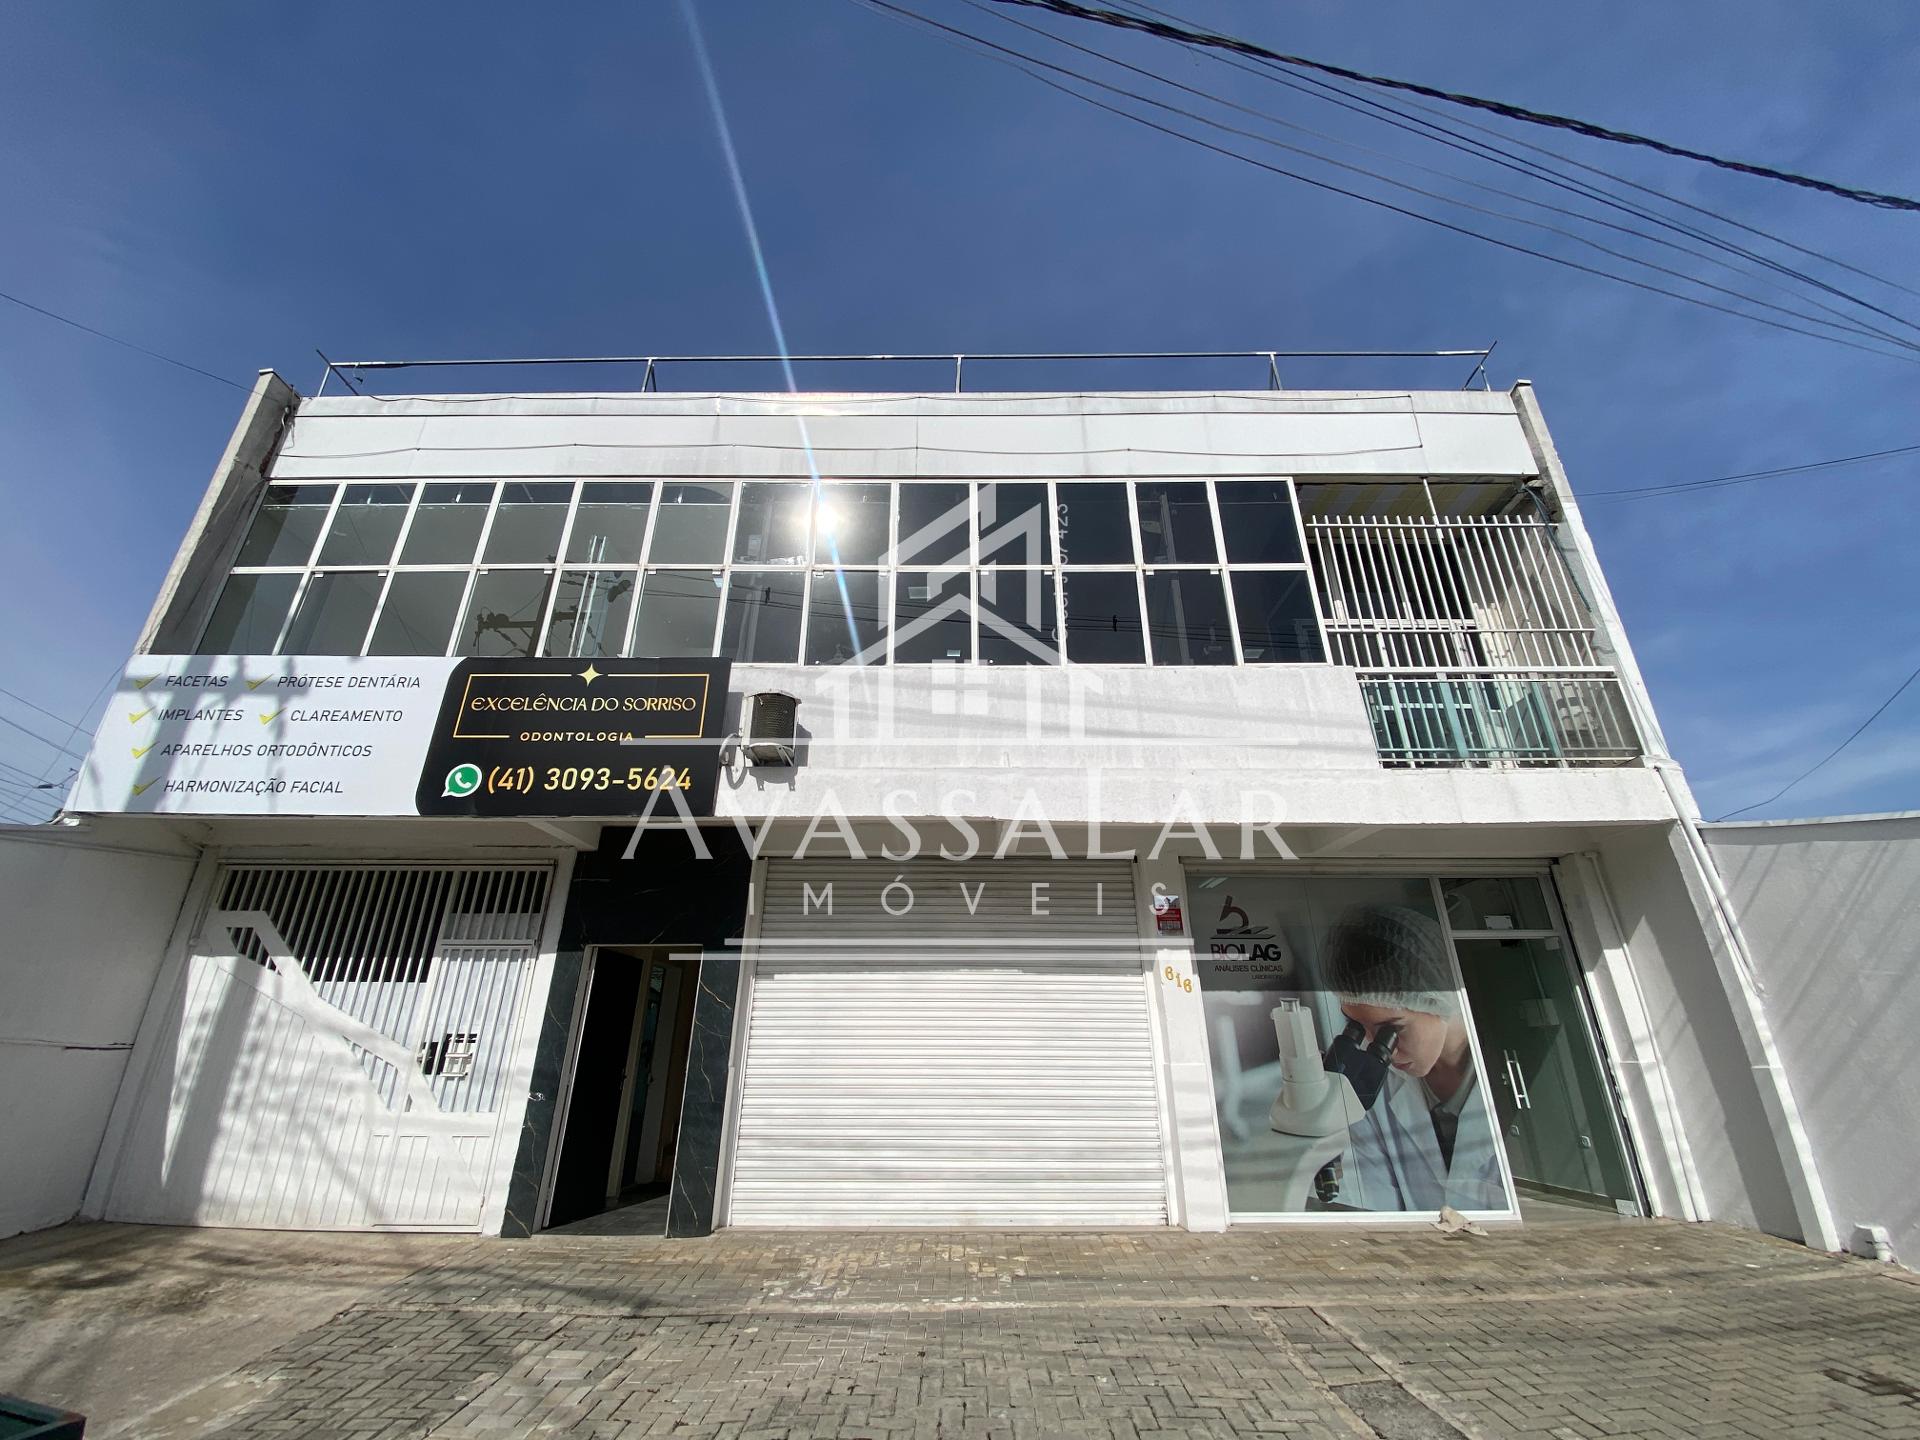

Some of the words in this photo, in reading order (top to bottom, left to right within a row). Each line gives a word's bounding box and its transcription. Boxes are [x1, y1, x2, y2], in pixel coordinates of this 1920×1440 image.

[164, 674, 229, 688] FACETAS
[276, 672, 345, 689] PRÓTESE
[347, 673, 421, 689] DENTÁRIA
[470, 692, 588, 712] EXCELÊNCIA
[591, 697, 619, 712] DO
[622, 696, 696, 712] SORRISO
[157, 708, 244, 722] IMPLANTES
[289, 709, 403, 723] CLAREAMENTO
[519, 731, 634, 742] ODONTOLOGIA
[160, 743, 252, 757] APARELHOS
[257, 741, 372, 758] ORTODÔNTICOS
[163, 777, 287, 796] HARMONIZAÇÃO
[289, 780, 344, 794] FACIAL
[487, 765, 534, 794] (41)
[544, 766, 692, 792] 3093-5624
[1210, 944, 1282, 962] BIOLAG
[1214, 964, 1250, 974] ANÁLISES
[1251, 963, 1284, 974] CLÍNICAS
